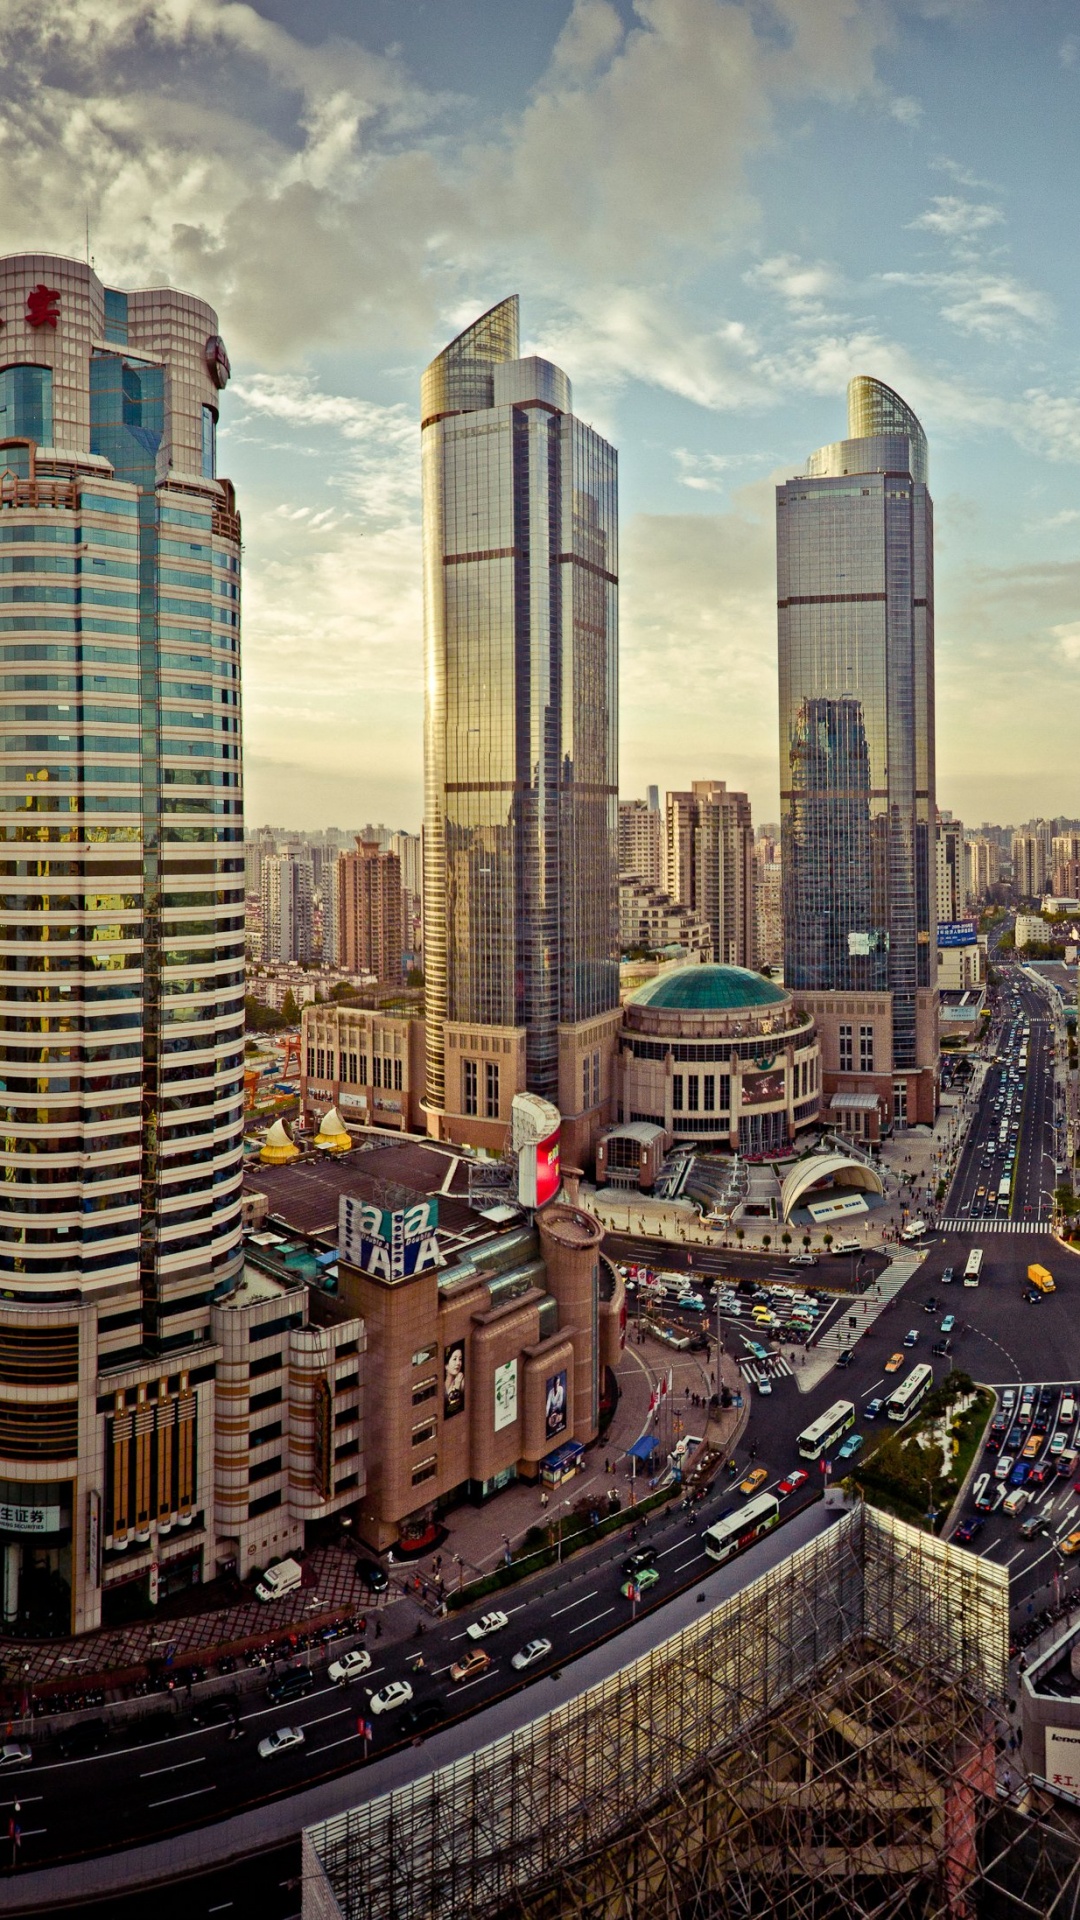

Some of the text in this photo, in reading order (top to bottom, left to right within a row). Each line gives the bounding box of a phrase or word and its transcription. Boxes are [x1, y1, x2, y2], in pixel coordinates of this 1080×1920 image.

[361, 1233, 390, 1250] Double A
[405, 1231, 432, 1246] Double
[367, 1245, 391, 1281] A
[414, 1236, 448, 1274] A
[1, 1507, 44, 1523] 生证券
